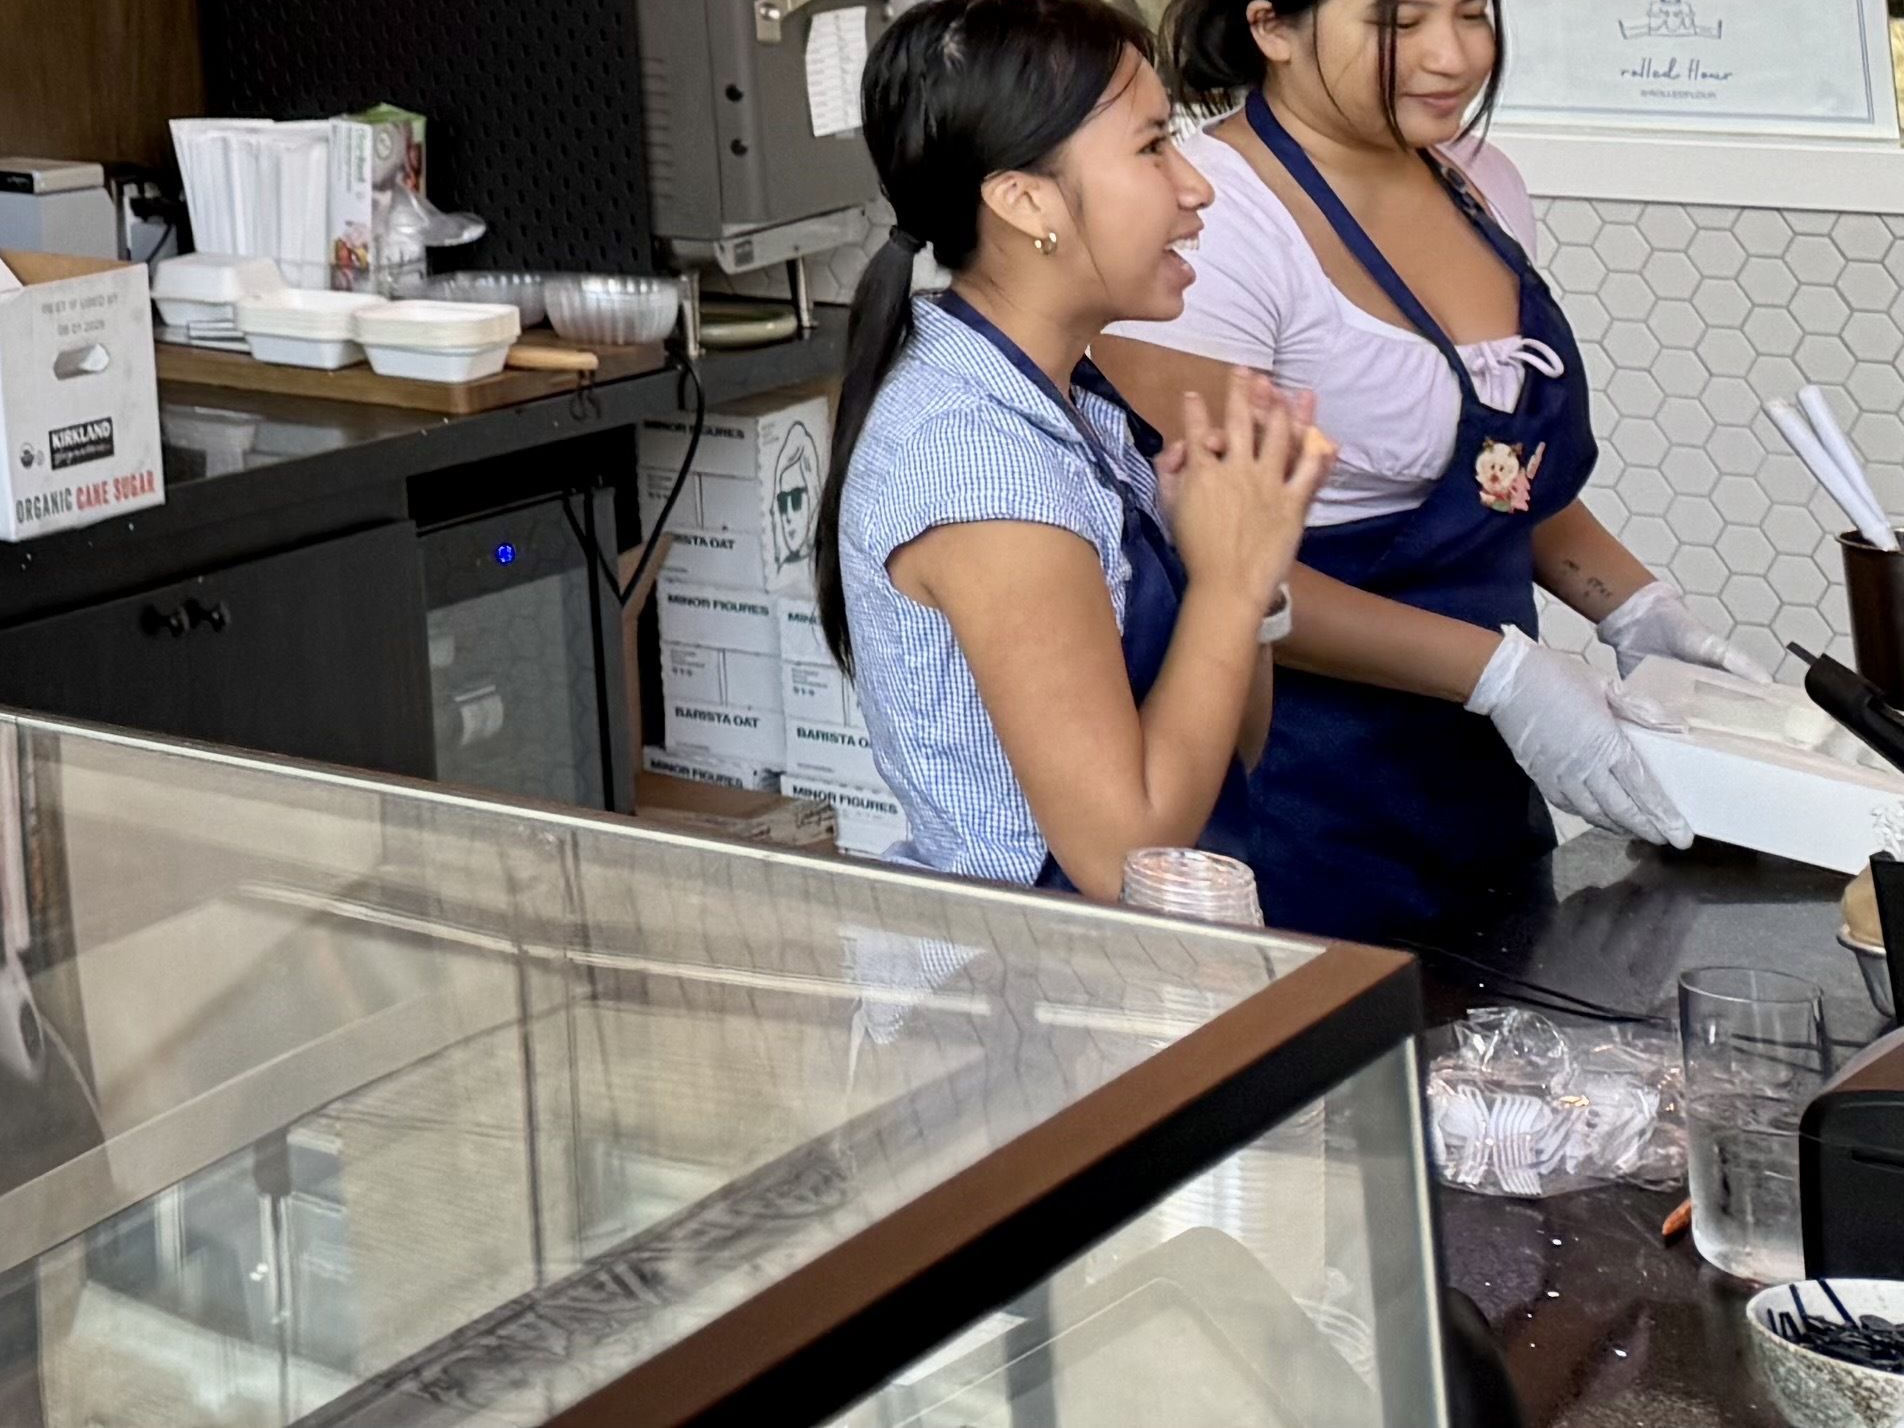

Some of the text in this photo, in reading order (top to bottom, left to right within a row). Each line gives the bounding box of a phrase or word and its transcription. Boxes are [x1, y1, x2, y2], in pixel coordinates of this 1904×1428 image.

[50, 421, 112, 450] KIRKLAND
[15, 470, 156, 524] ORGANIC CANE SUGAR
[667, 593, 769, 617] MINOR FIGURES
[674, 705, 760, 729] BARISTA OAT
[792, 784, 837, 805] MINOR
